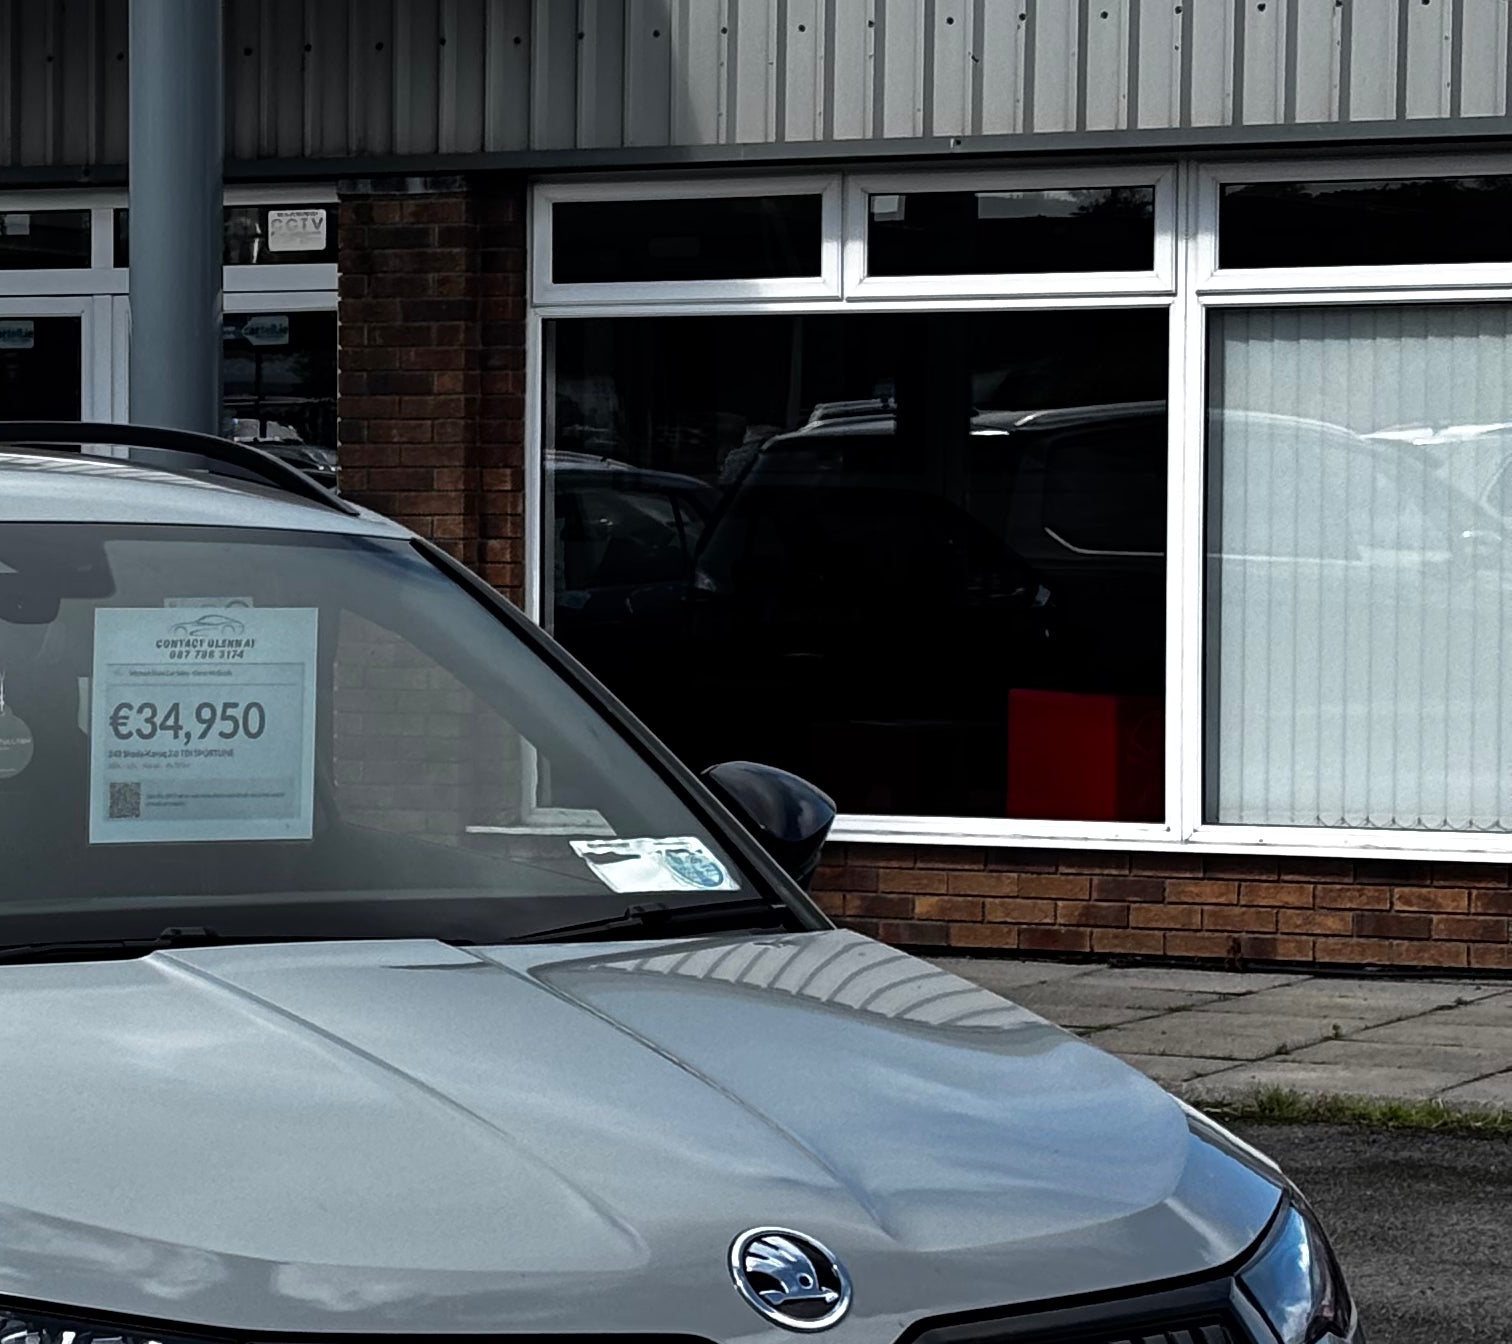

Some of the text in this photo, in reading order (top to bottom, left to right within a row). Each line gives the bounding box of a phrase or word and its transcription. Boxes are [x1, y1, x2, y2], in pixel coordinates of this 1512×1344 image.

[271, 217, 324, 232] CCTV
[156, 639, 205, 649] CONTACT
[109, 701, 266, 745] €34,950
